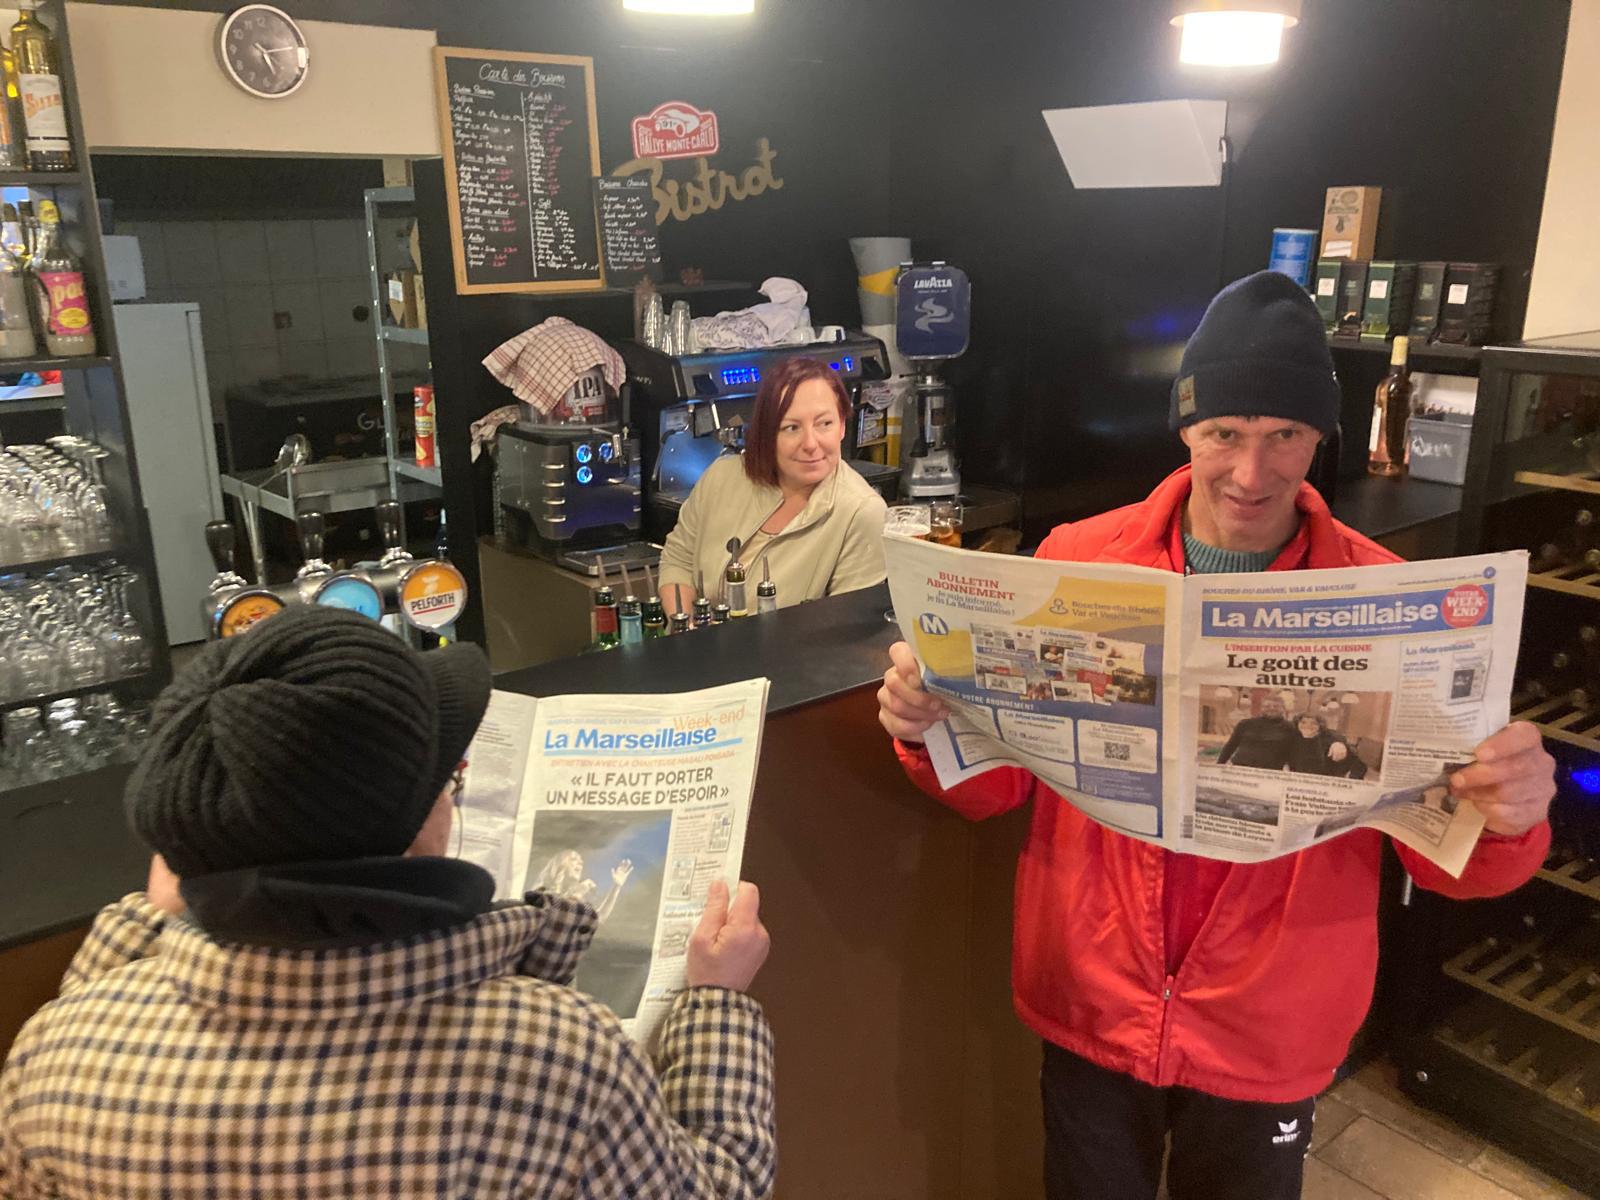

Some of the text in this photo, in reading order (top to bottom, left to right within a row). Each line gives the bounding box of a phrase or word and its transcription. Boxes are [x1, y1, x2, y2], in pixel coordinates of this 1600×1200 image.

[612, 137, 784, 226] Bistrot
[913, 276, 952, 289] LAVAZZA
[926, 577, 1016, 601] ABONNEMENT
[939, 571, 999, 589] BULLETIN
[411, 594, 455, 611] PELFORTH
[1453, 607, 1479, 617] END
[922, 614, 947, 635] M
[1212, 602, 1438, 628] La Marseillaise
[1225, 644, 1372, 653] L'INSERTION PAR LA CUISINE
[1227, 654, 1368, 673] Le goût des
[1256, 672, 1336, 688] autres
[672, 704, 746, 731] Week-end
[544, 727, 717, 750] La Marseillaise
[586, 772, 599, 786] IL
[604, 773, 652, 787] FAUT
[655, 767, 713, 785] PORTER
[546, 790, 568, 805] UN
[572, 790, 651, 806] MESSAGE
[655, 785, 719, 804] D'ESPOIR
